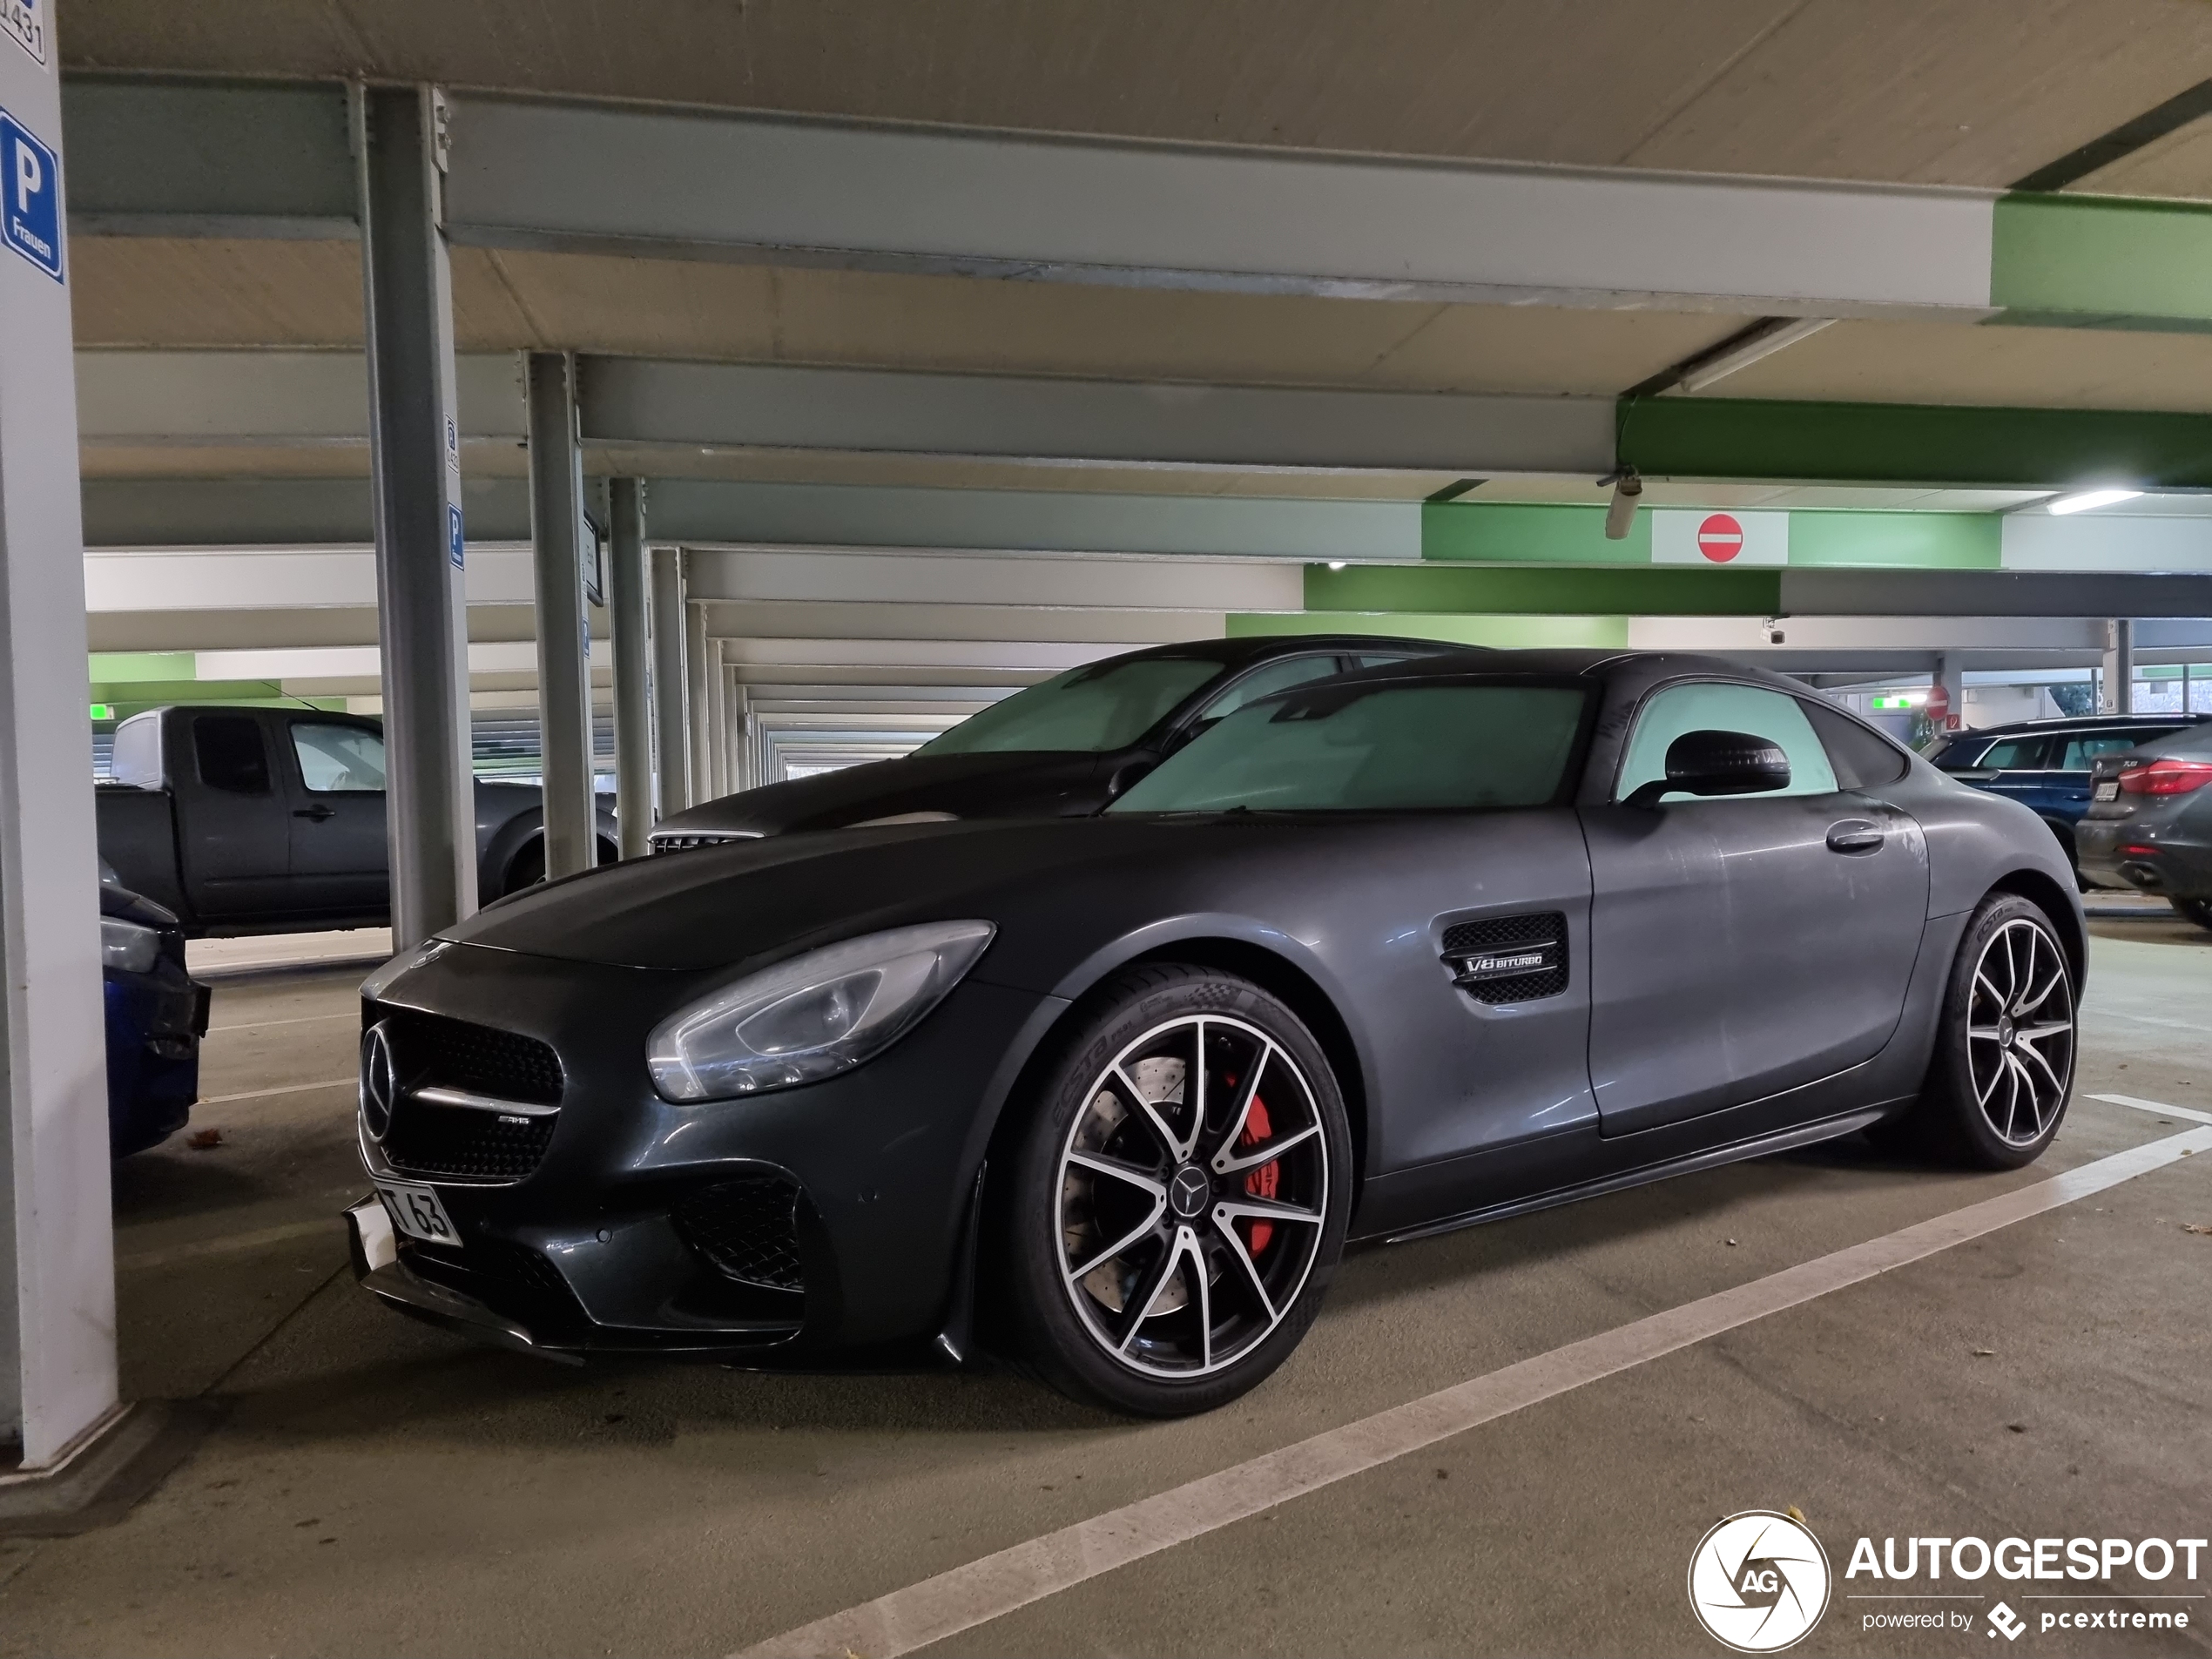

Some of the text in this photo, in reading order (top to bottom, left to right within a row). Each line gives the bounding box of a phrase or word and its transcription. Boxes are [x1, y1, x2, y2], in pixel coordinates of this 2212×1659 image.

[16, 138, 41, 213] P
[13, 215, 51, 260] Frauen
[452, 512, 459, 546] P
[1467, 955, 1542, 972] V8 BITURBO
[407, 1192, 449, 1238] 63
